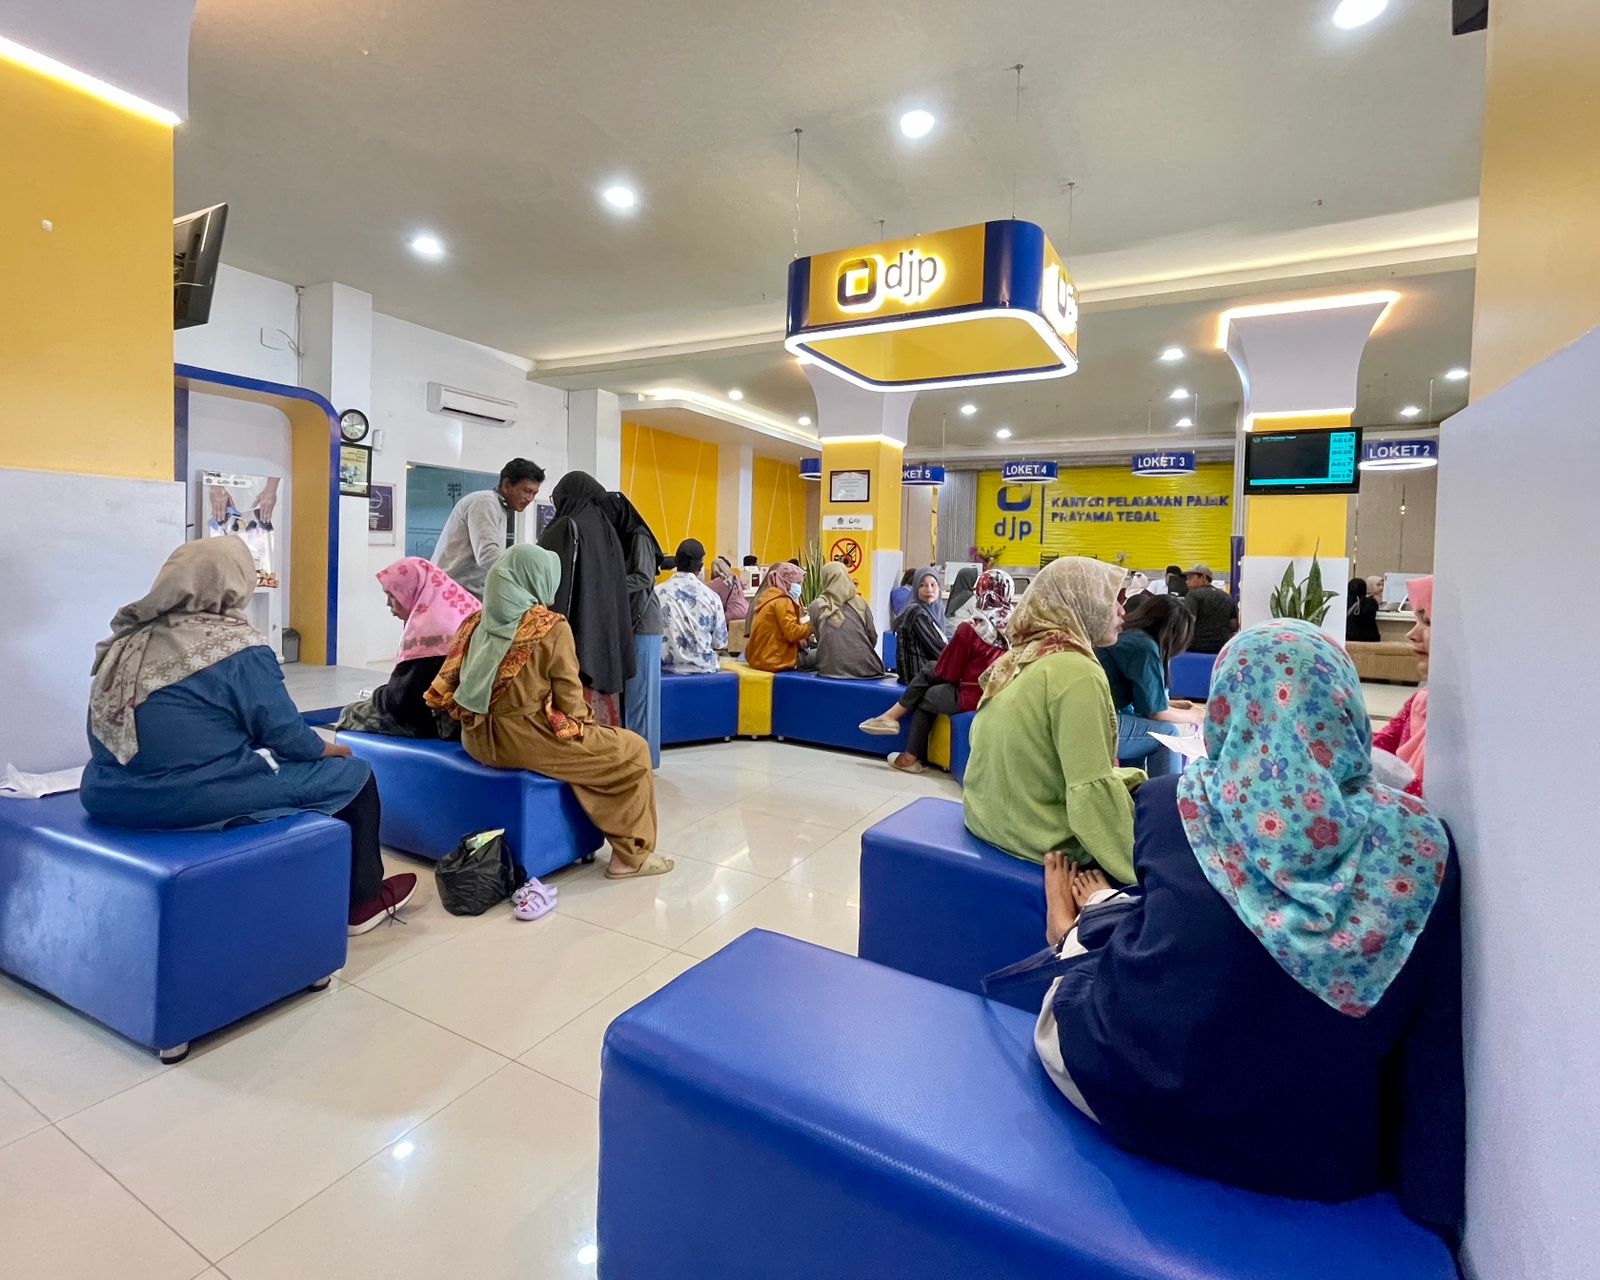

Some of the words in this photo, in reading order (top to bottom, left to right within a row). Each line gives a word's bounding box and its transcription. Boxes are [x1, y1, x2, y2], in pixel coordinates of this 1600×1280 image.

[884, 249, 937, 297] djp
[1369, 445, 1420, 459] LOKET
[1423, 445, 1430, 456] 2
[1138, 456, 1176, 468] LOKET
[1179, 457, 1186, 467] 3
[902, 470, 923, 479] KET
[924, 470, 931, 479] 5
[1006, 465, 1040, 476] LOKET
[1041, 465, 1047, 474] 4
[1051, 496, 1105, 508] KANTOR
[1107, 495, 1183, 507] PELAYANAN
[1051, 510, 1114, 522] PRATAMA
[1116, 511, 1160, 522] TEGAL
[994, 516, 1032, 541] djp
